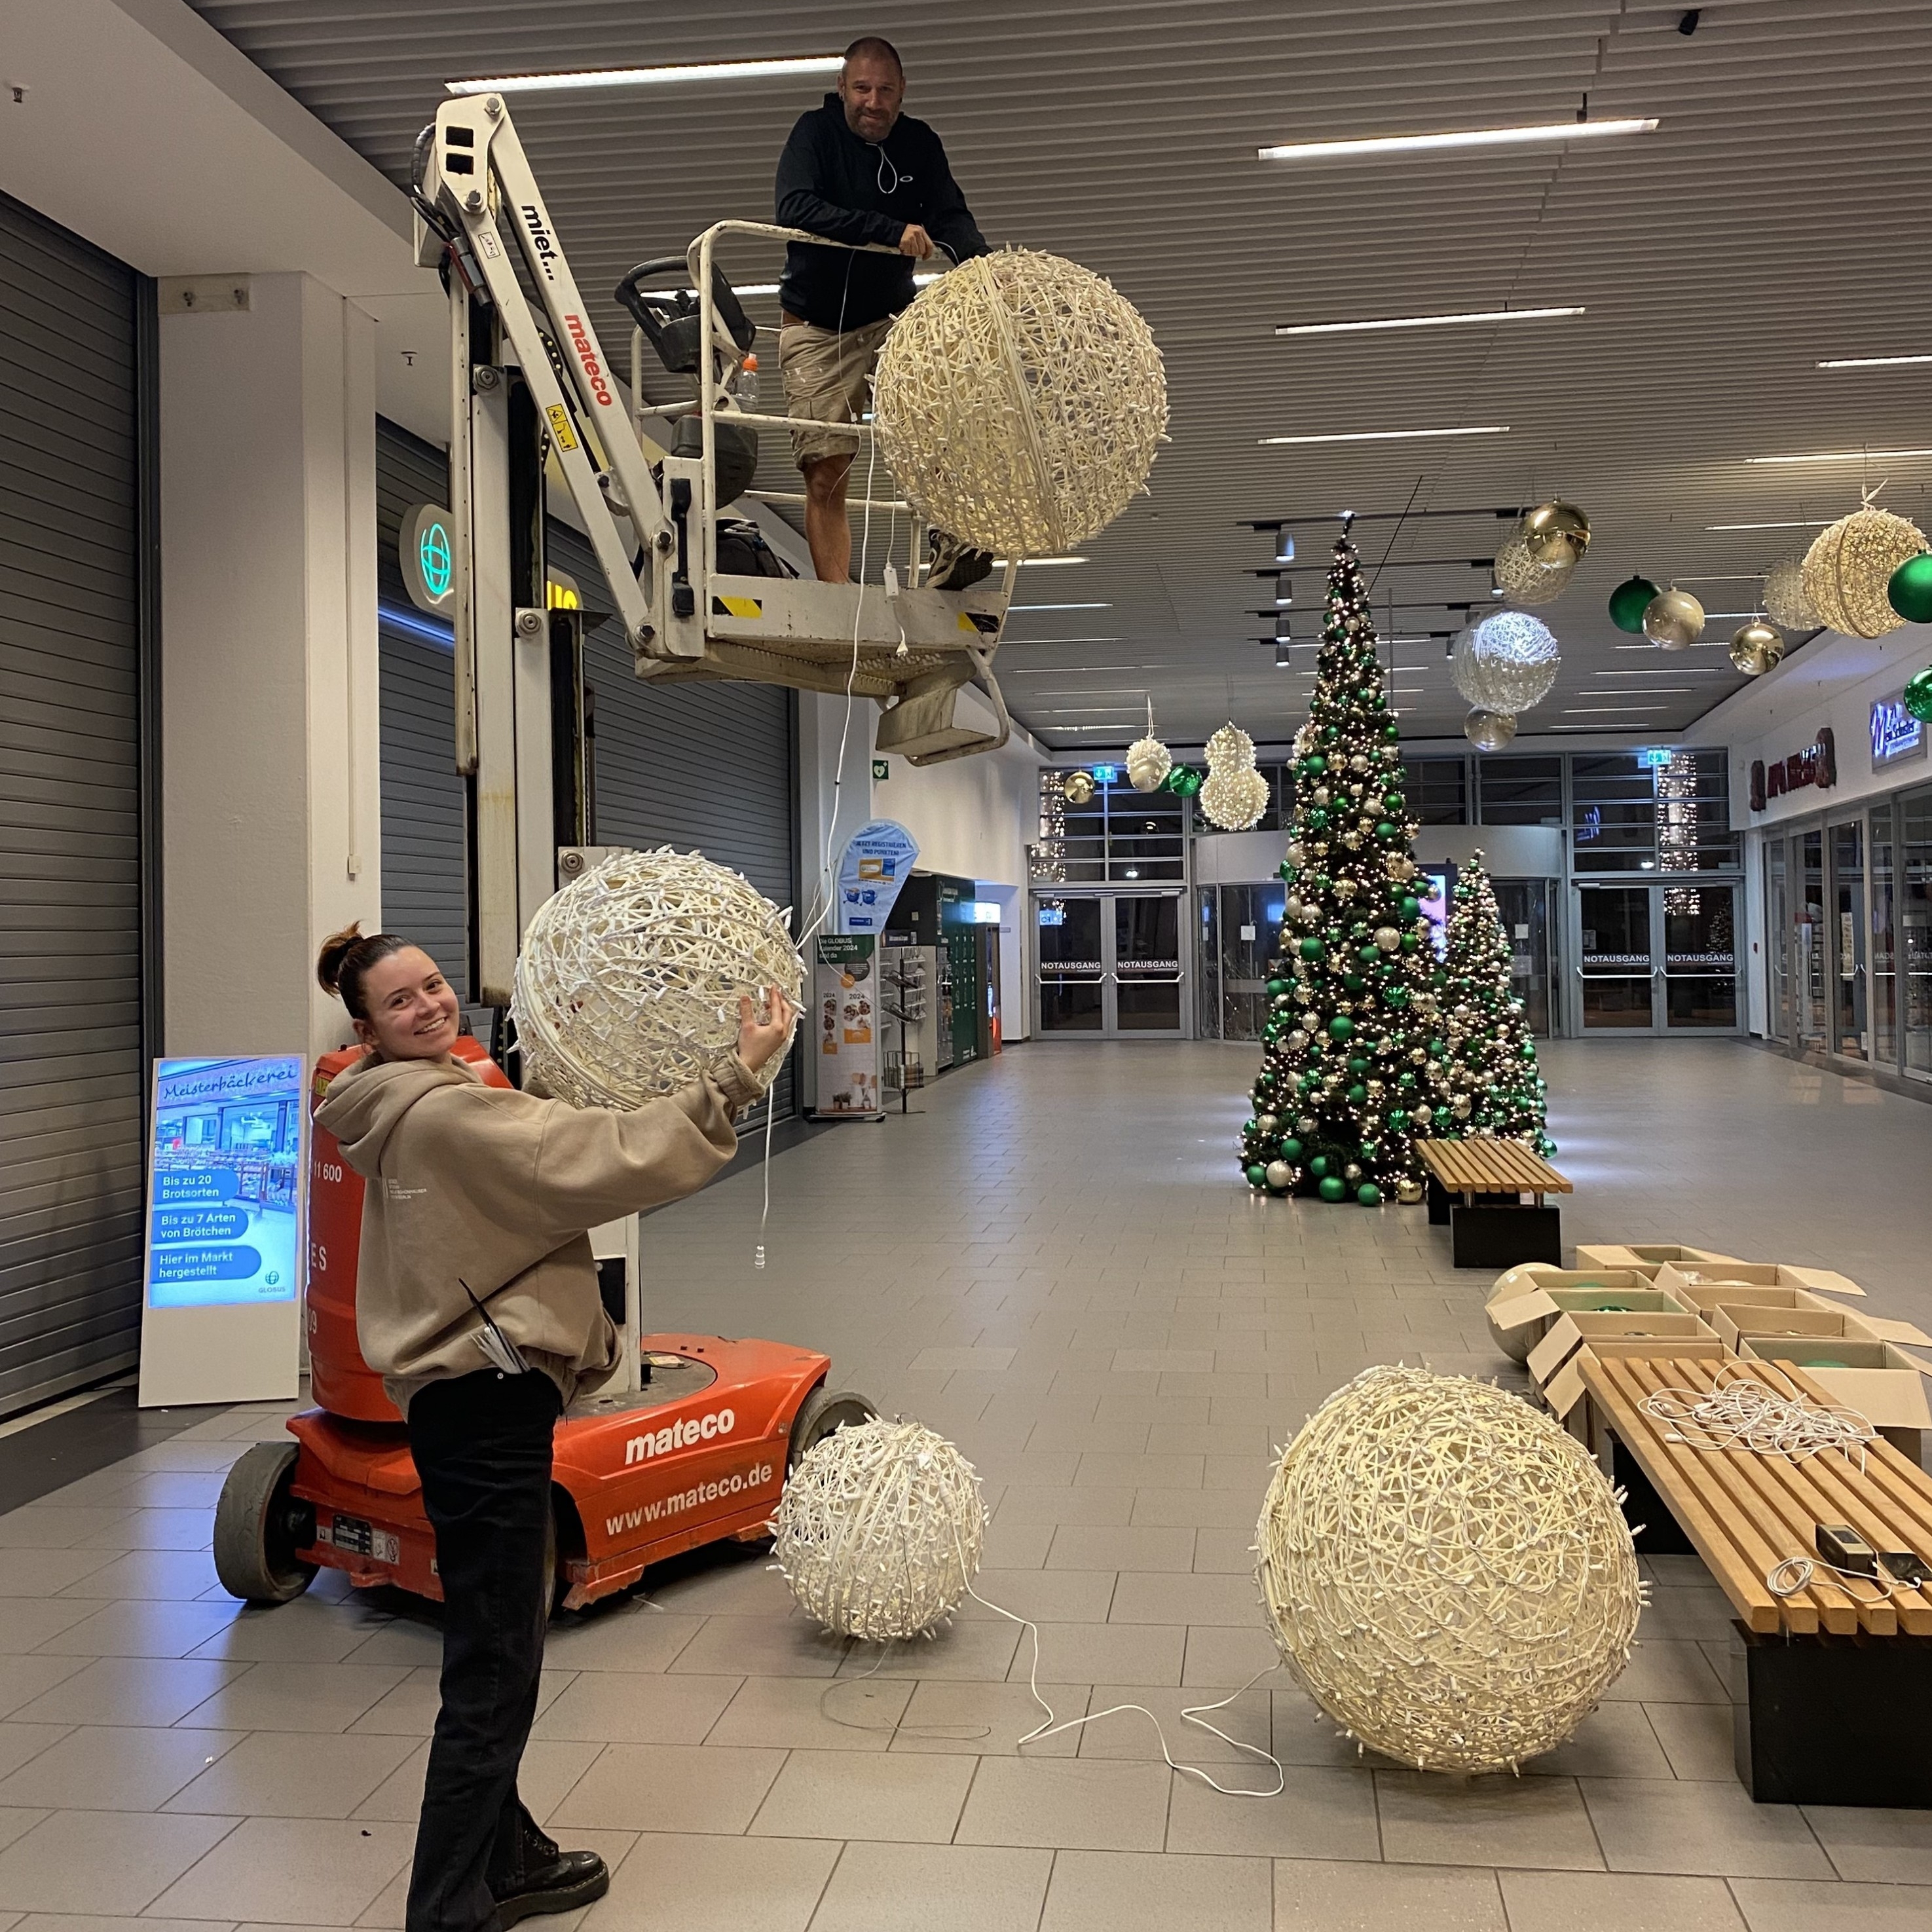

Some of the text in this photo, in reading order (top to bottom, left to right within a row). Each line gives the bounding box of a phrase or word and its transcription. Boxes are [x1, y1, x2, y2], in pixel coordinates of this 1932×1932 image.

[521, 206, 558, 280] miet...
[565, 315, 612, 406] mateco
[164, 1065, 297, 1099] Meisterbäckerei
[162, 1176, 180, 1186] Bis
[198, 1175, 212, 1184] 20
[323, 1163, 343, 1183] 600
[162, 1187, 219, 1199] Brotsorten
[161, 1216, 178, 1225] Bis
[196, 1214, 204, 1223] 7
[206, 1213, 236, 1223] Arten
[161, 1226, 231, 1238] von Brötchen
[160, 1252, 233, 1265] Hier im Markt
[158, 1265, 217, 1278] hergestellt
[625, 1408, 735, 1466] mateco
[606, 1461, 773, 1536] www.mateco.de
